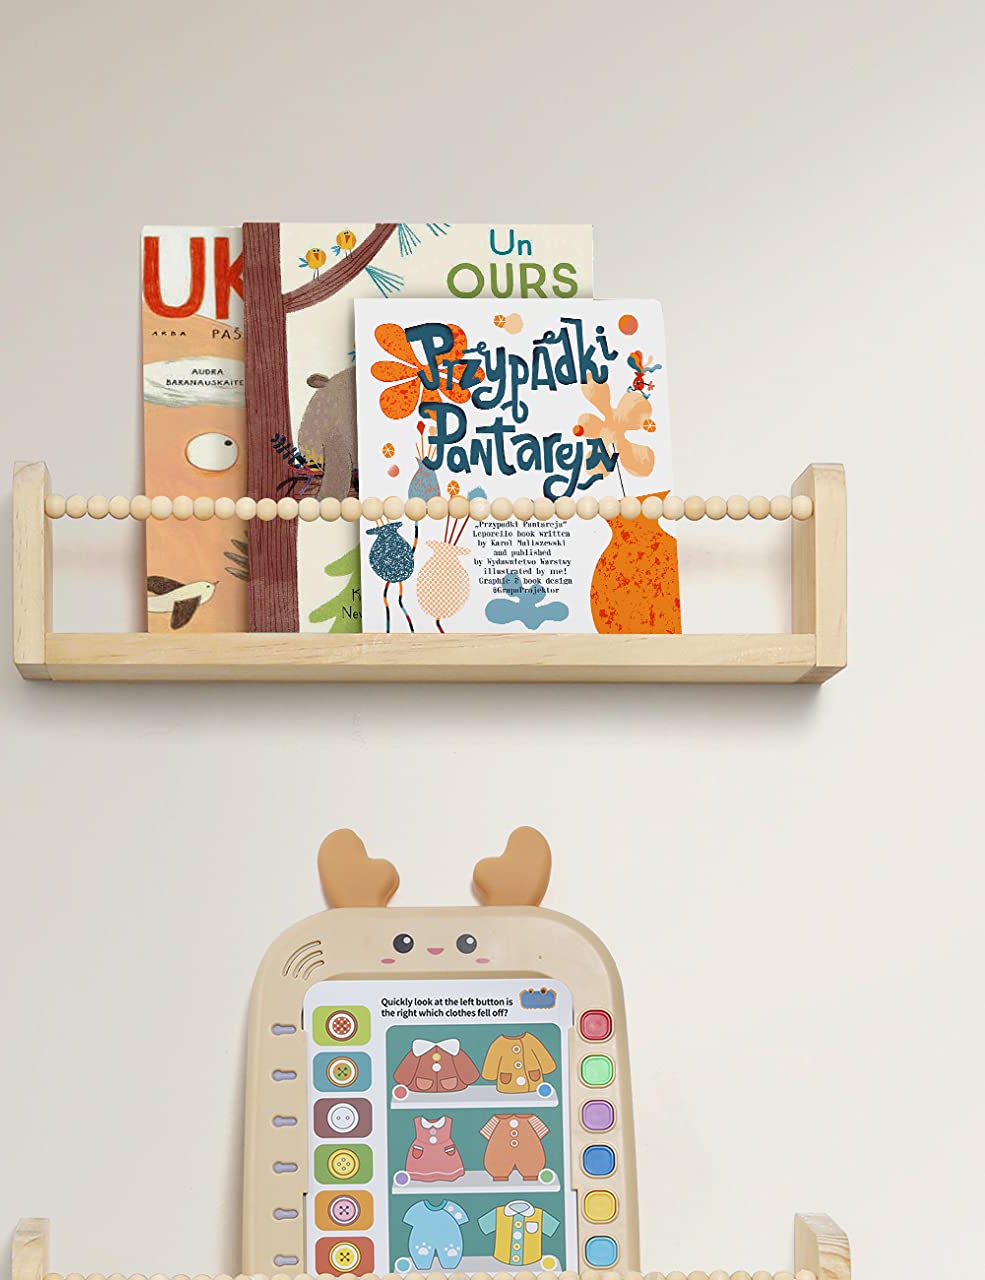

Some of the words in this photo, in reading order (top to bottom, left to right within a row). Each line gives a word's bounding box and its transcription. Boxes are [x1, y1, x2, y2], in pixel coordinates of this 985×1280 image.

[489, 229, 532, 256] Un
[447, 262, 578, 299] OURS
[191, 368, 224, 376] AUDRA
[516, 530, 535, 538] book
[539, 530, 571, 538] written
[477, 539, 487, 548] by
[491, 539, 513, 547] Karol
[511, 549, 552, 557] published
[473, 558, 483, 567] by
[536, 568, 546, 576] by
[523, 577, 542, 585] book
[545, 577, 573, 585] design
[380, 997, 413, 1008] Quickly
[414, 997, 433, 1006] look
[434, 998, 444, 1006] at
[444, 997, 459, 1006] the
[459, 997, 475, 1006] left
[475, 997, 504, 1006] button
[505, 997, 514, 1006] is
[381, 1008, 396, 1017] the
[396, 1008, 417, 1019] right
[418, 1008, 444, 1017] which
[445, 1008, 477, 1017] clothes
[477, 1008, 491, 1017] fell
[491, 1008, 509, 1017] off?
